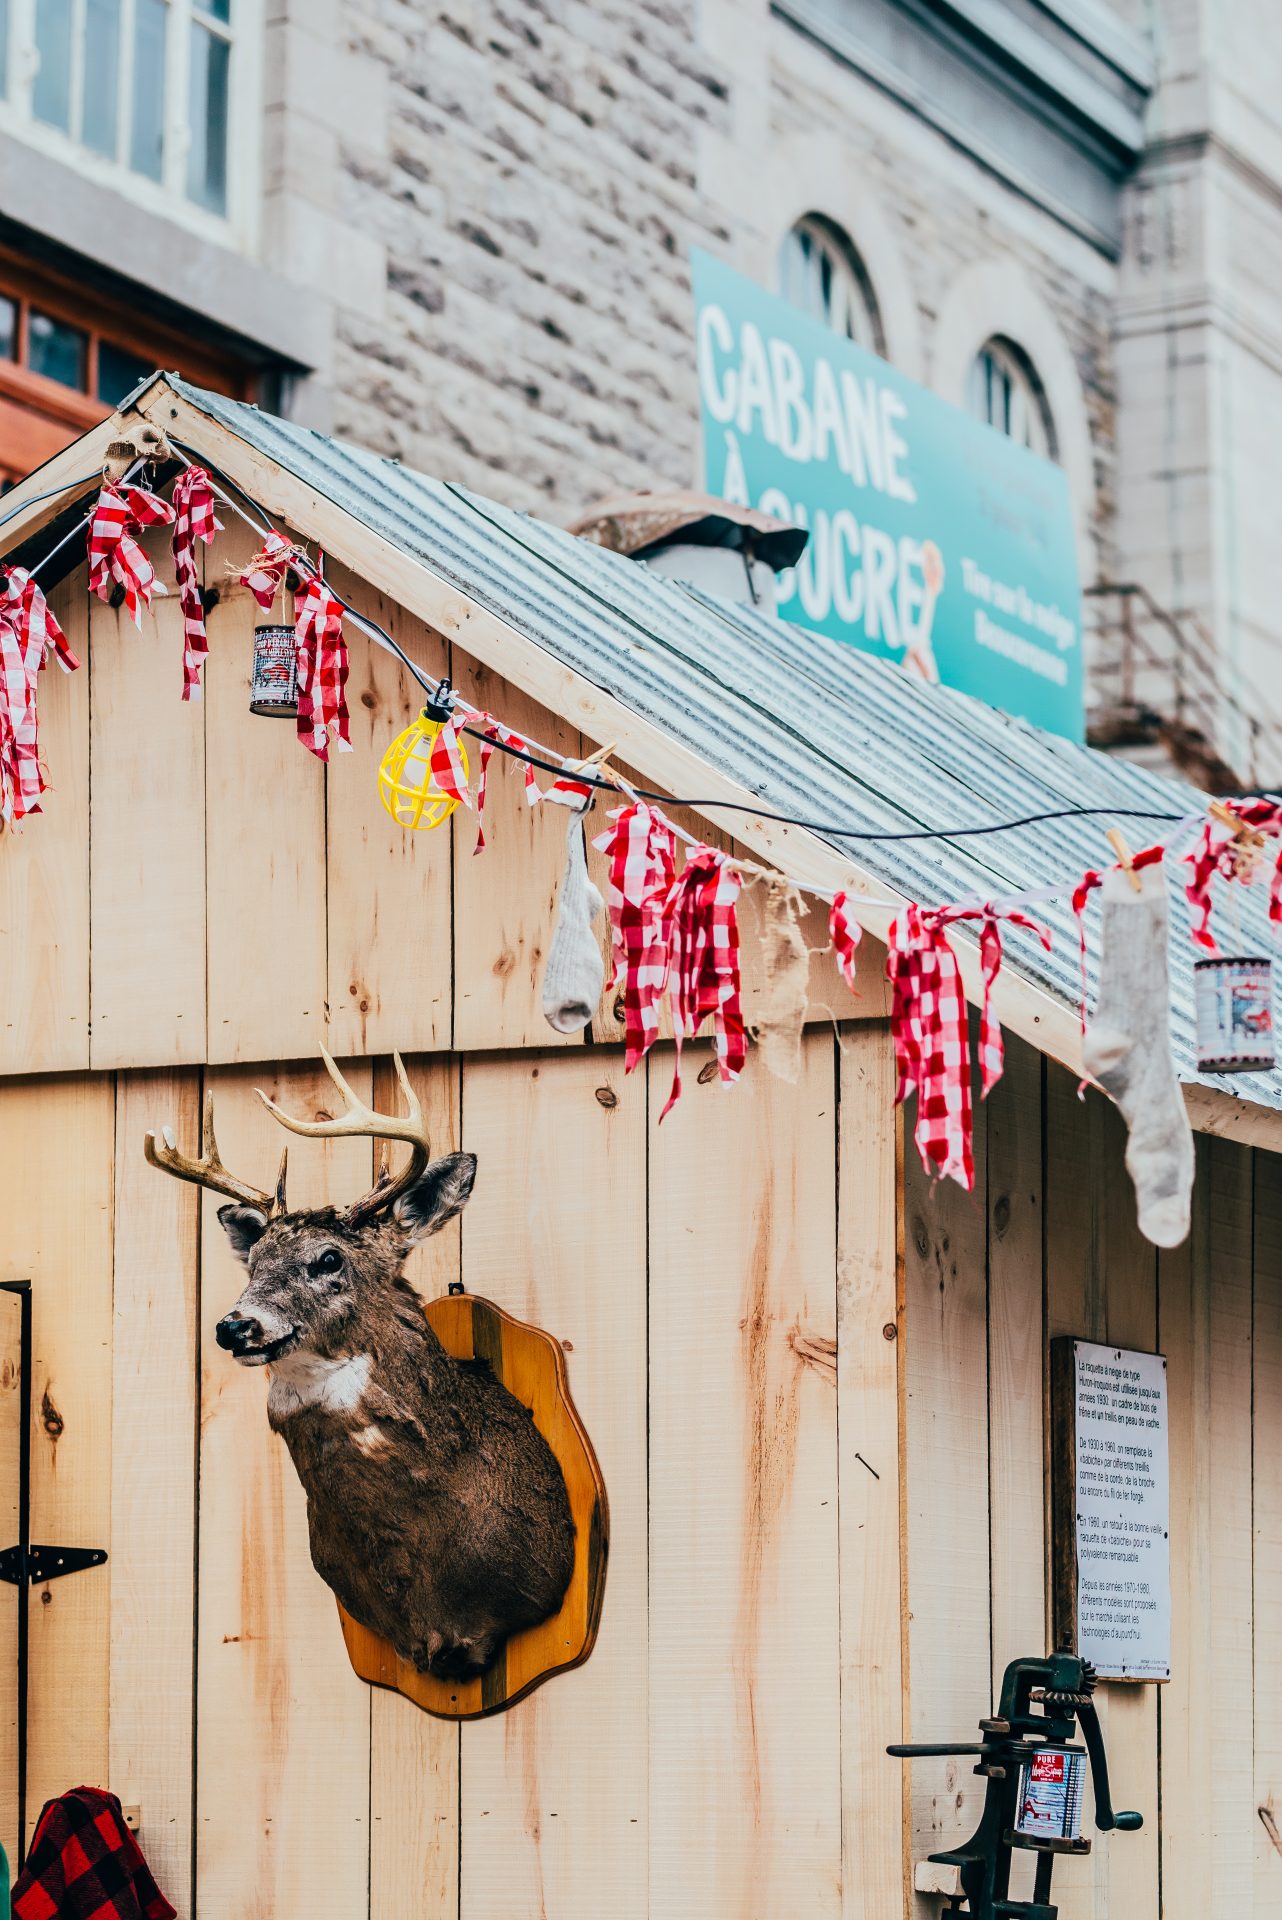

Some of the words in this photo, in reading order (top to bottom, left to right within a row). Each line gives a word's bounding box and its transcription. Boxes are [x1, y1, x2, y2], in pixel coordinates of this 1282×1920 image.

[699, 304, 918, 503] CABANE
[1079, 1360, 1085, 1370] La
[1086, 1361, 1104, 1375] raquette
[1104, 1364, 1108, 1373] à
[1109, 1366, 1122, 1379] neige
[1122, 1367, 1129, 1378] de
[1130, 1370, 1140, 1382] type
[1079, 1375, 1112, 1392] Huron-Iroquois
[1121, 1383, 1138, 1395] utilisée
[1138, 1386, 1160, 1400] jusqu'aux
[1079, 1392, 1096, 1404] années
[1112, 1398, 1117, 1407] un
[1118, 1398, 1132, 1410] cadre
[1133, 1400, 1140, 1410] de
[1140, 1401, 1150, 1412] bois
[1151, 1403, 1156, 1414] de
[1079, 1406, 1090, 1418] frêne
[1092, 1409, 1096, 1419] et
[1098, 1411, 1104, 1420] un
[1104, 1410, 1117, 1422] treillis
[1118, 1414, 1124, 1424] en
[1126, 1415, 1138, 1426] peau
[1138, 1416, 1144, 1426] de
[1080, 1436, 1086, 1448] De
[1088, 1438, 1099, 1450] 1930
[1118, 1445, 1124, 1454] on
[1124, 1446, 1146, 1458] remplace
[1148, 1445, 1152, 1458] la
[1104, 1458, 1112, 1470] par
[1112, 1458, 1134, 1471] différents
[1135, 1460, 1150, 1472] treillis
[1080, 1470, 1096, 1480] comme
[1098, 1470, 1104, 1482] de
[1104, 1472, 1108, 1482] la
[1124, 1474, 1132, 1486] de
[1132, 1476, 1138, 1486] la
[1080, 1486, 1086, 1495] ou
[1087, 1486, 1103, 1498] encore
[1104, 1488, 1110, 1498] du
[1116, 1488, 1122, 1500] de
[1080, 1514, 1086, 1526] En
[1102, 1520, 1108, 1528] un
[1109, 1520, 1123, 1530] retour
[1128, 1520, 1134, 1531] la
[1134, 1522, 1149, 1533] bonne
[1080, 1533, 1100, 1544] raquette
[1100, 1534, 1106, 1544] de
[1133, 1538, 1144, 1548] pour
[1145, 1540, 1151, 1548] sa
[1080, 1548, 1108, 1560] polyvalence
[1081, 1578, 1098, 1591] Depuis
[1106, 1581, 1122, 1592] années
[1081, 1594, 1102, 1606] différents
[1104, 1597, 1122, 1608] modèles
[1124, 1598, 1134, 1608] sont
[1134, 1600, 1156, 1610] proposés
[1081, 1611, 1089, 1620] sur
[1090, 1610, 1094, 1621] le
[1096, 1611, 1112, 1622] marché
[1114, 1612, 1131, 1624] utilisant
[1132, 1612, 1140, 1624] les
[1081, 1626, 1110, 1640] technologies
[1037, 1755, 1056, 1764] PURE
